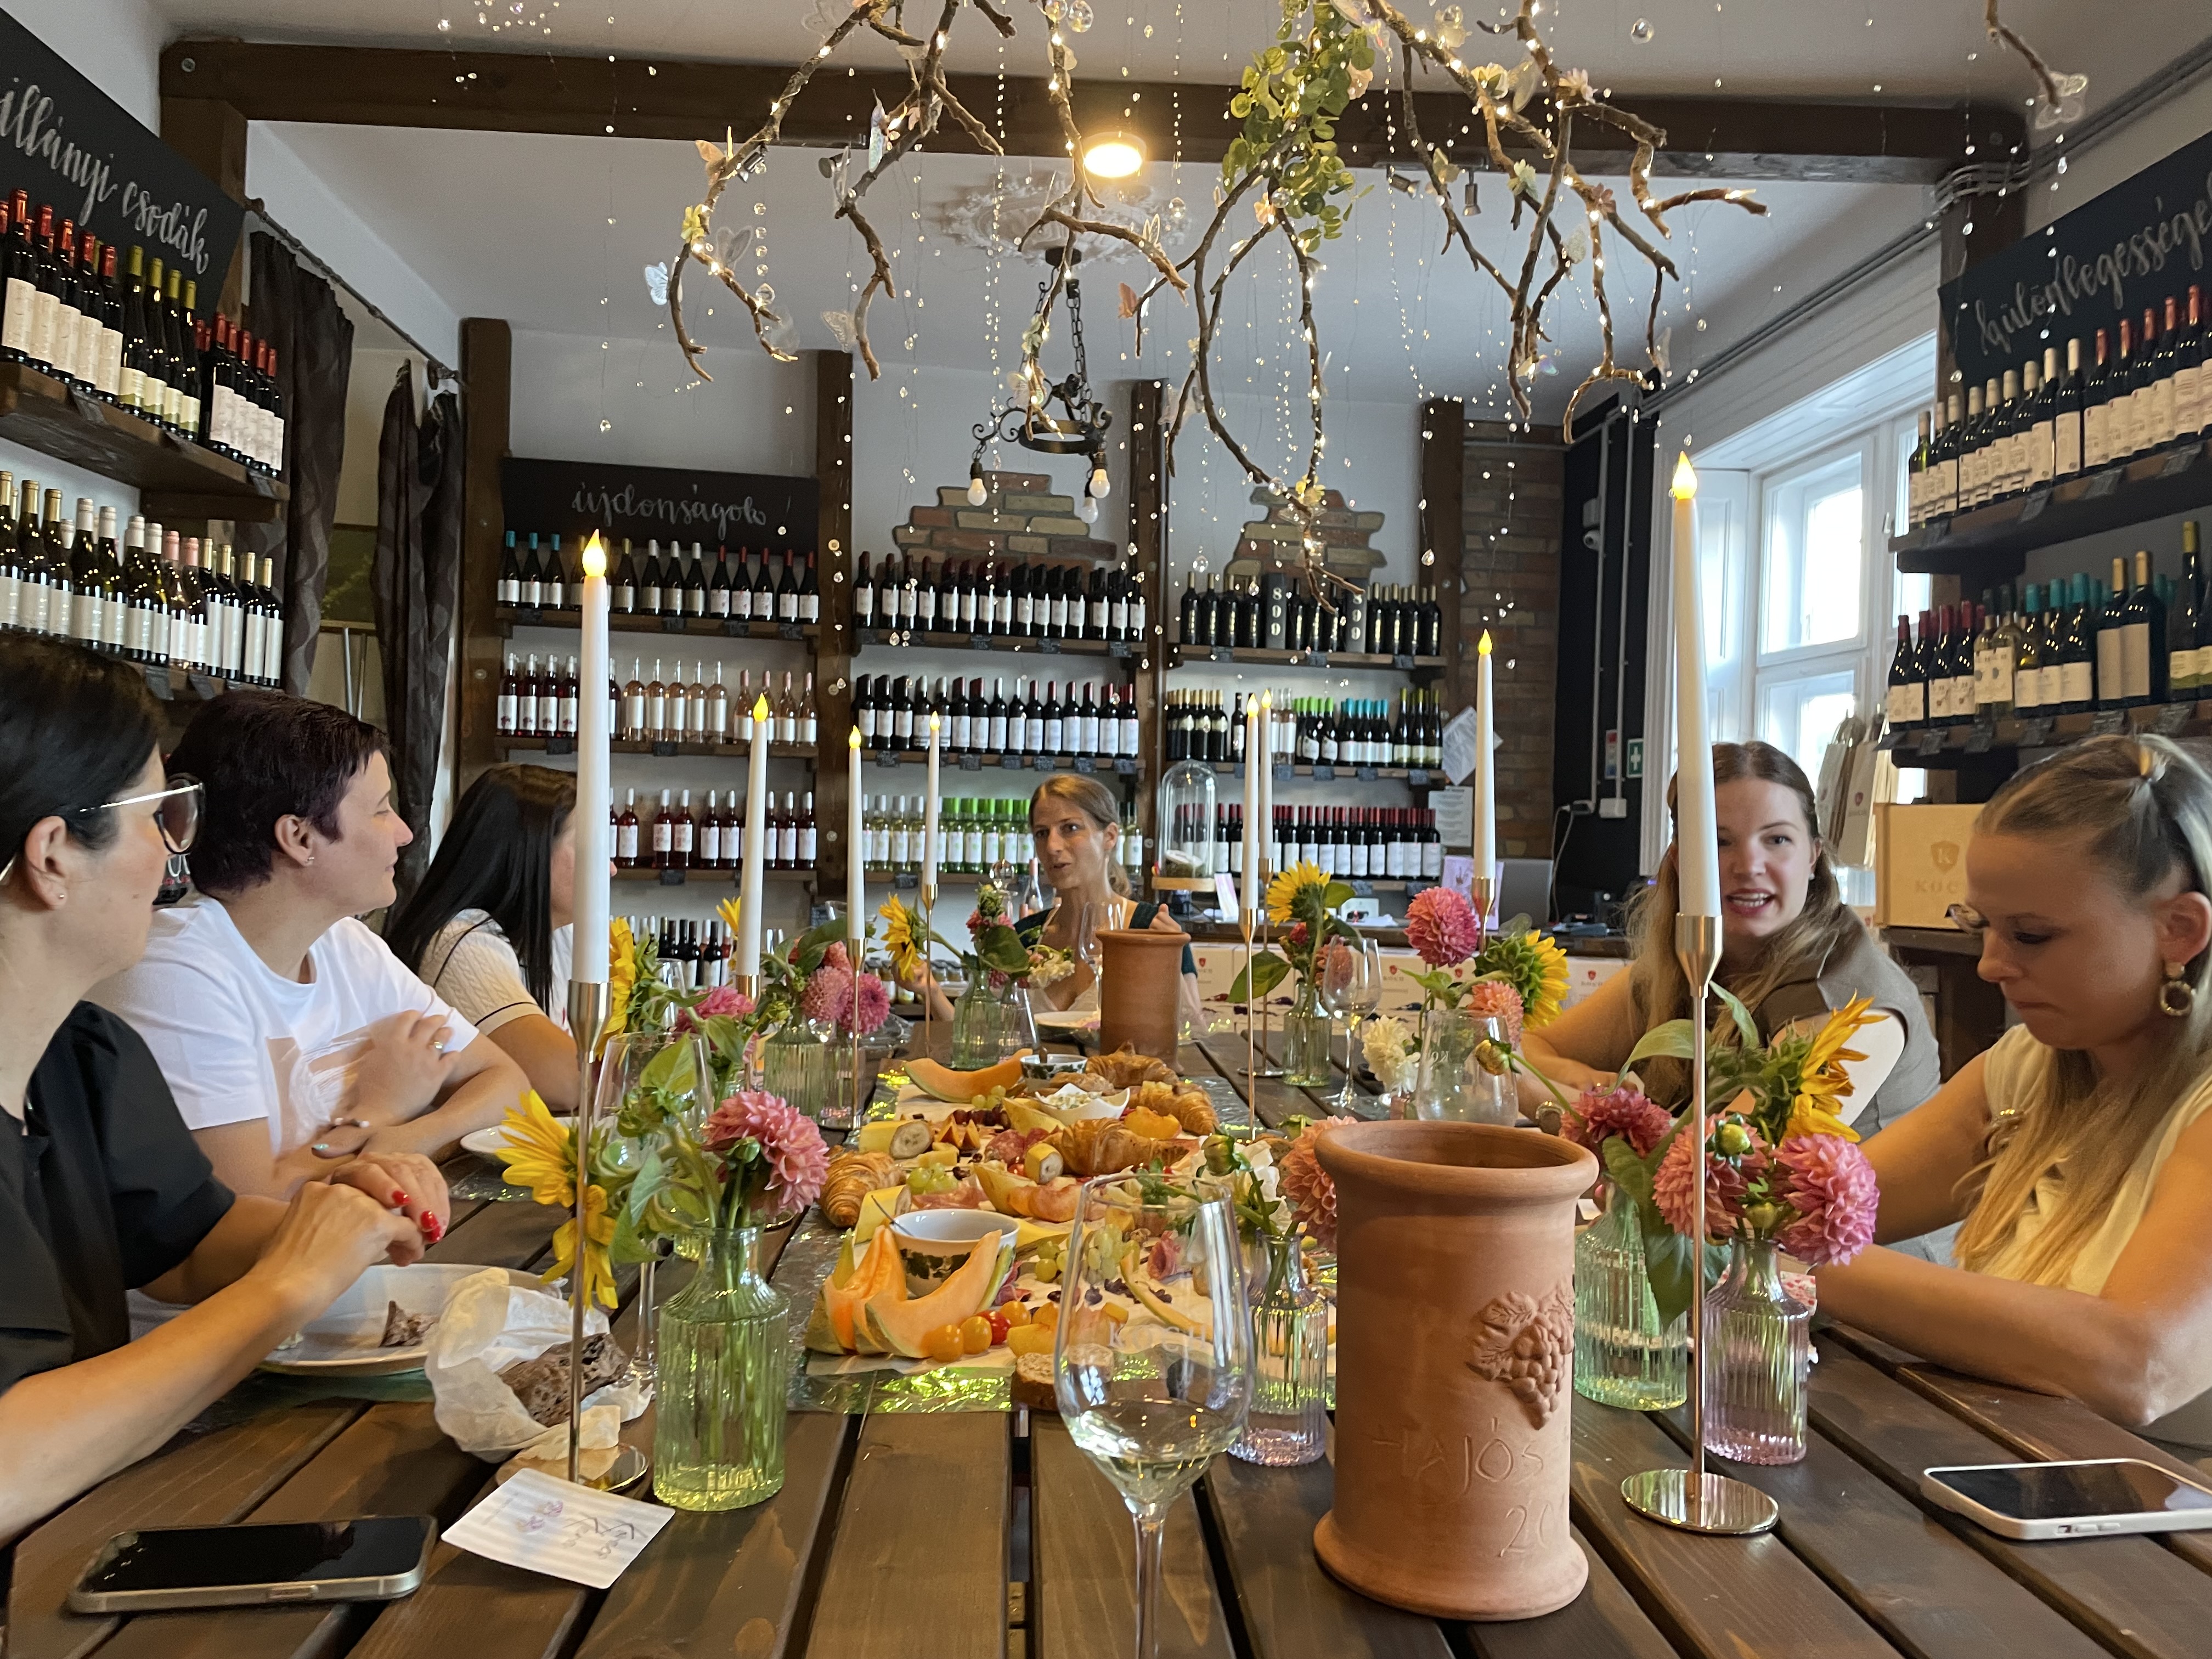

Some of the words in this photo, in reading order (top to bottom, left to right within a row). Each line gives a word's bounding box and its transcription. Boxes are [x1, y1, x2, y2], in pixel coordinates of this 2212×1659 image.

[0, 77, 118, 227] illányi
[122, 181, 209, 274] csodák
[1976, 171, 2212, 356] különlegessége
[572, 482, 766, 540] újdonságok
